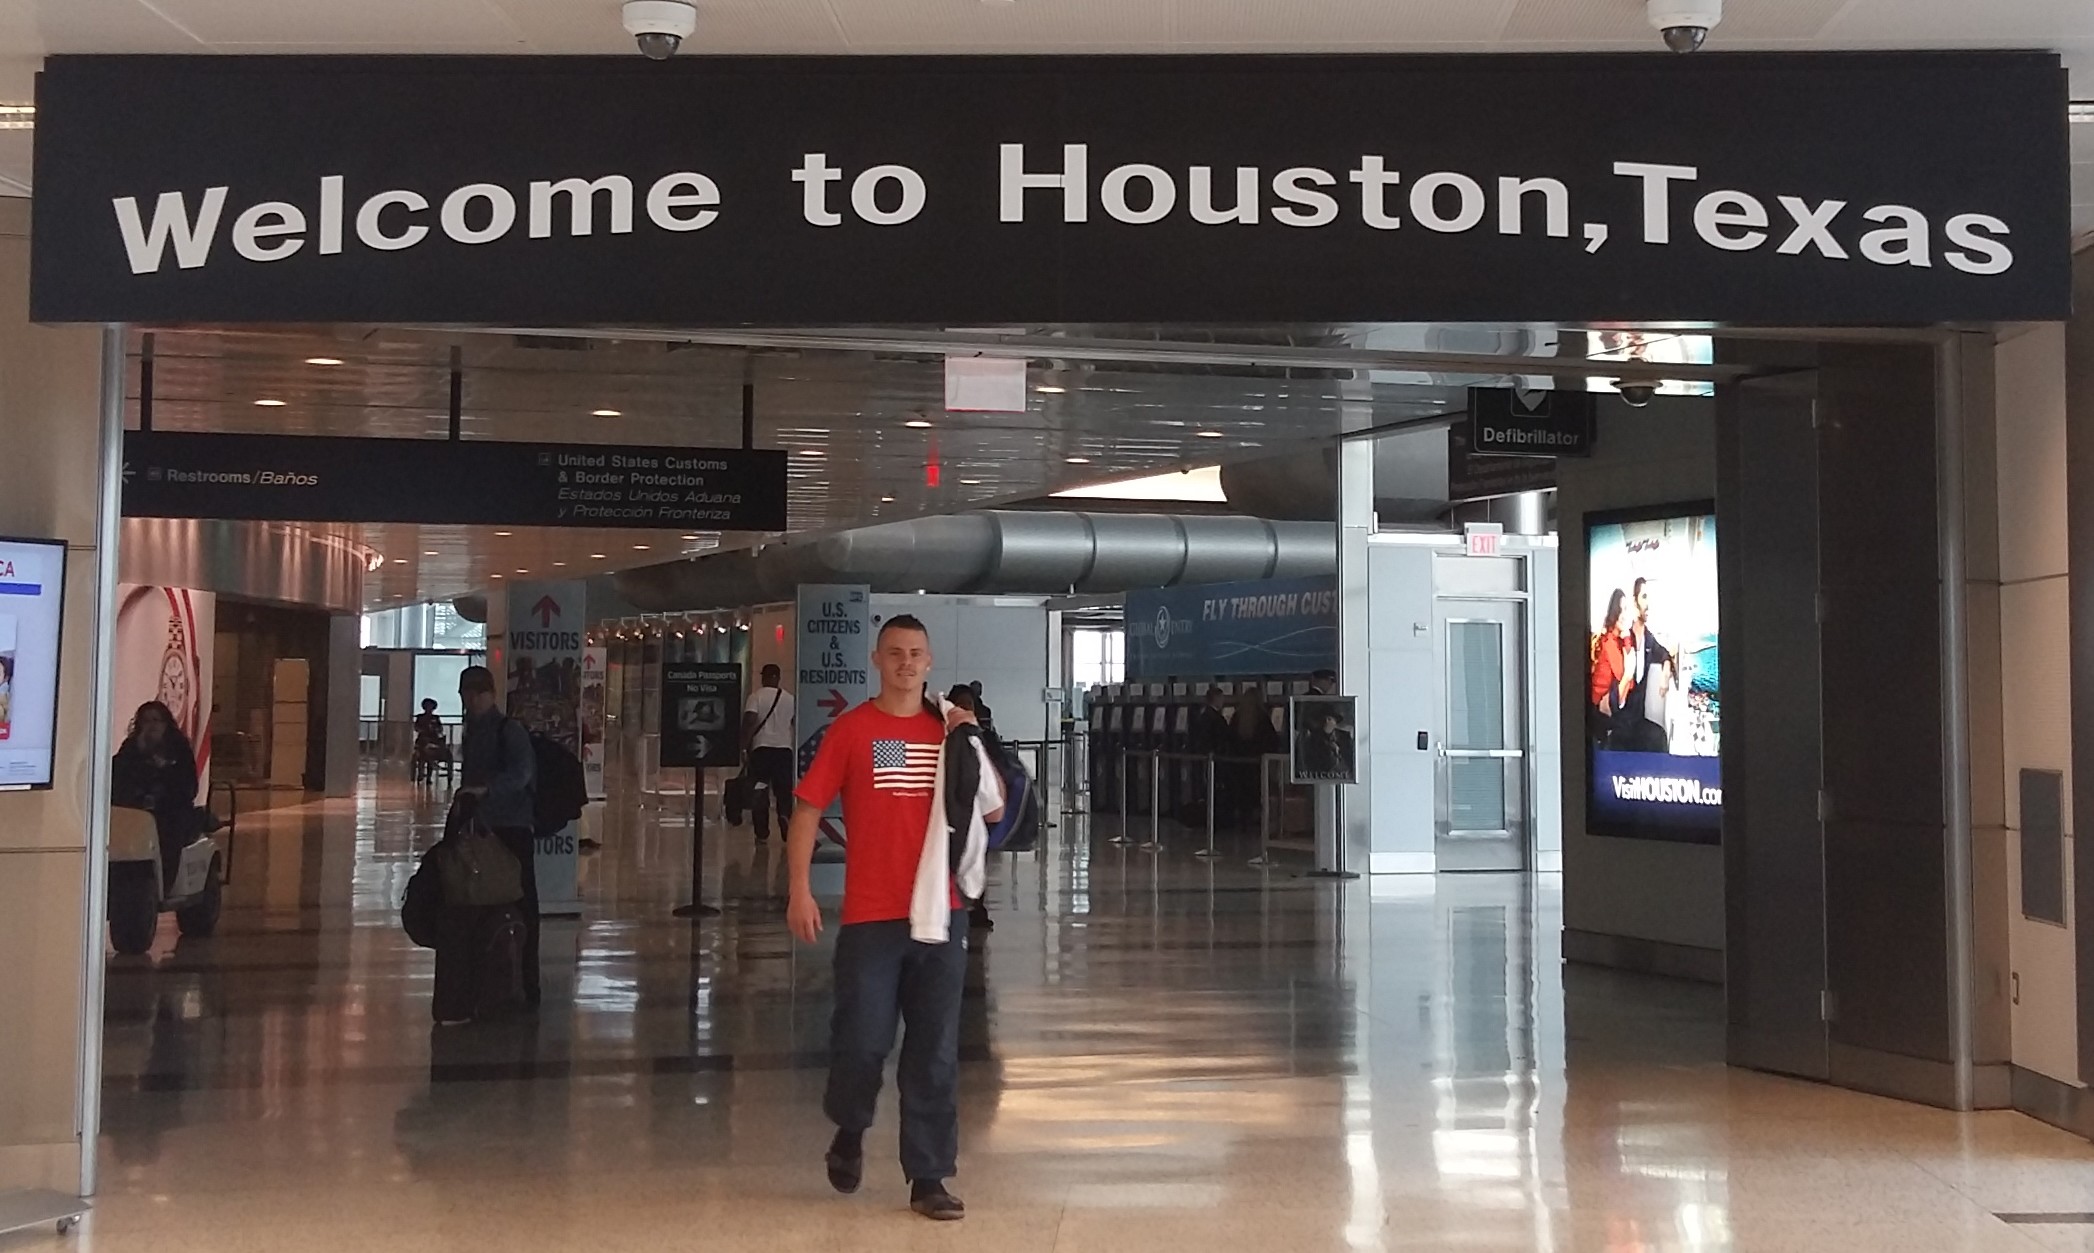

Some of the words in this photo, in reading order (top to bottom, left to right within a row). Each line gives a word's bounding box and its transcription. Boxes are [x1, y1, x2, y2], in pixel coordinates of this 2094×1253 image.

[112, 171, 721, 275] Welcome
[791, 153, 927, 227] to
[1613, 161, 2013, 275] Texas
[1483, 427, 1578, 445] Defibrillator
[557, 454, 605, 467] United
[611, 455, 659, 468] States
[664, 457, 728, 471] Customs
[557, 471, 568, 484] &
[575, 472, 625, 484] Border
[630, 472, 705, 486] Protection
[557, 487, 622, 501] Estados
[628, 488, 679, 502] Unidos
[684, 491, 742, 504] Aduana
[557, 508, 567, 519] y
[572, 504, 654, 518] Protección
[658, 506, 731, 520] Fronteriza
[1472, 535, 1497, 554] EXIT
[822, 602, 847, 617] U.S.
[1202, 598, 1229, 621] FLY
[1231, 594, 1298, 619] THROUGH
[807, 619, 861, 634] CITIZENS
[510, 631, 579, 650] VISITORS
[829, 636, 840, 650] &
[821, 652, 847, 668] U.S.
[667, 671, 697, 679] Canada
[698, 671, 737, 680] Passports
[800, 670, 866, 685] RESIDENTS
[686, 684, 699, 692] No
[536, 835, 574, 855] TORS
